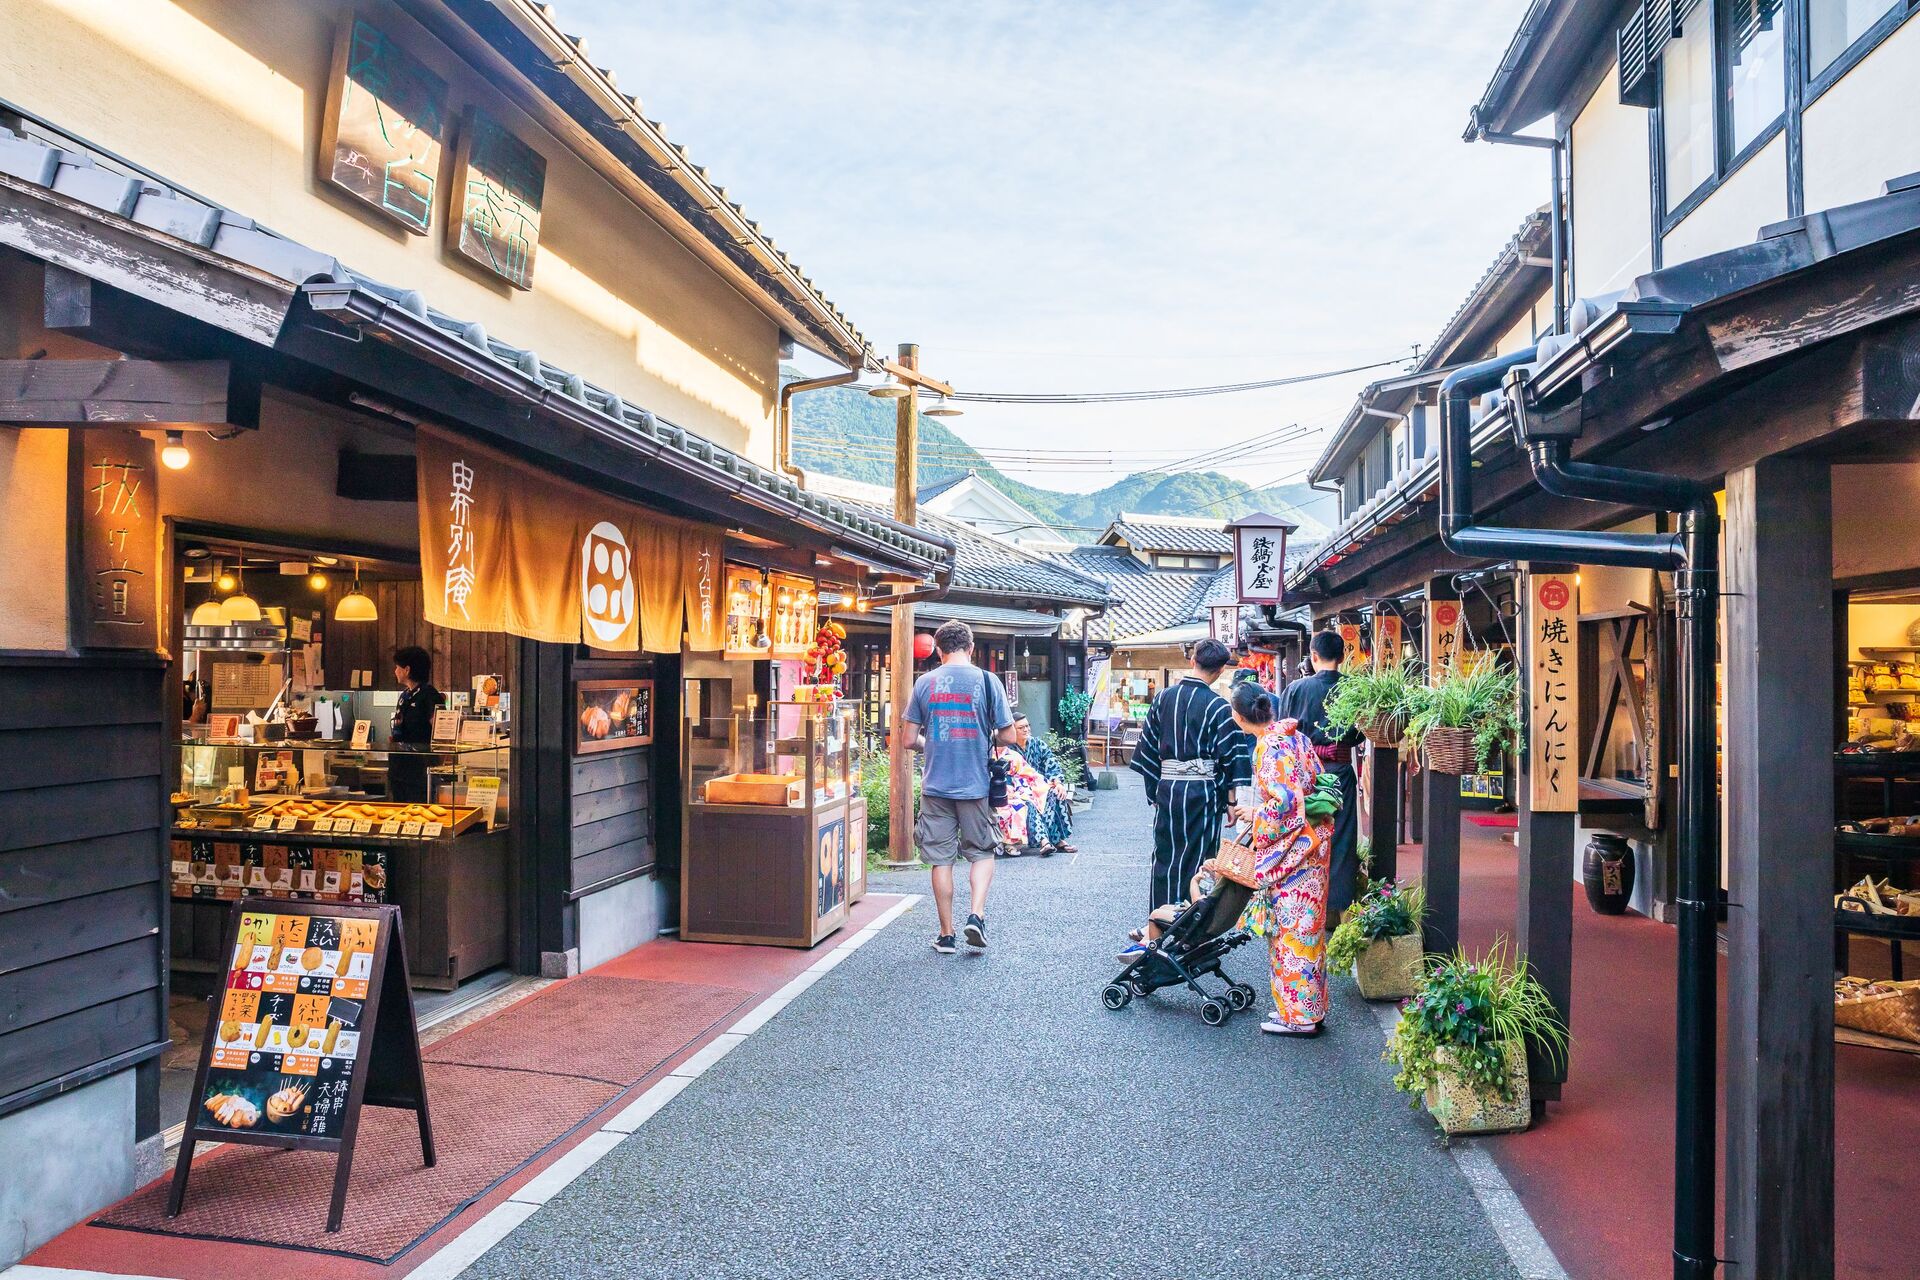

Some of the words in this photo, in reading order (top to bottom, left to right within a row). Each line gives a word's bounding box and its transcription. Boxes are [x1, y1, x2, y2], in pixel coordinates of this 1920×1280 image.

[91, 456, 145, 626] 抜け道
[1540, 617, 1569, 795] 焼きにんにく
[289, 919, 304, 943] たこ
[319, 920, 339, 947] えび
[269, 995, 284, 1021] チーズ
[311, 1082, 333, 1134] 天婦羅
